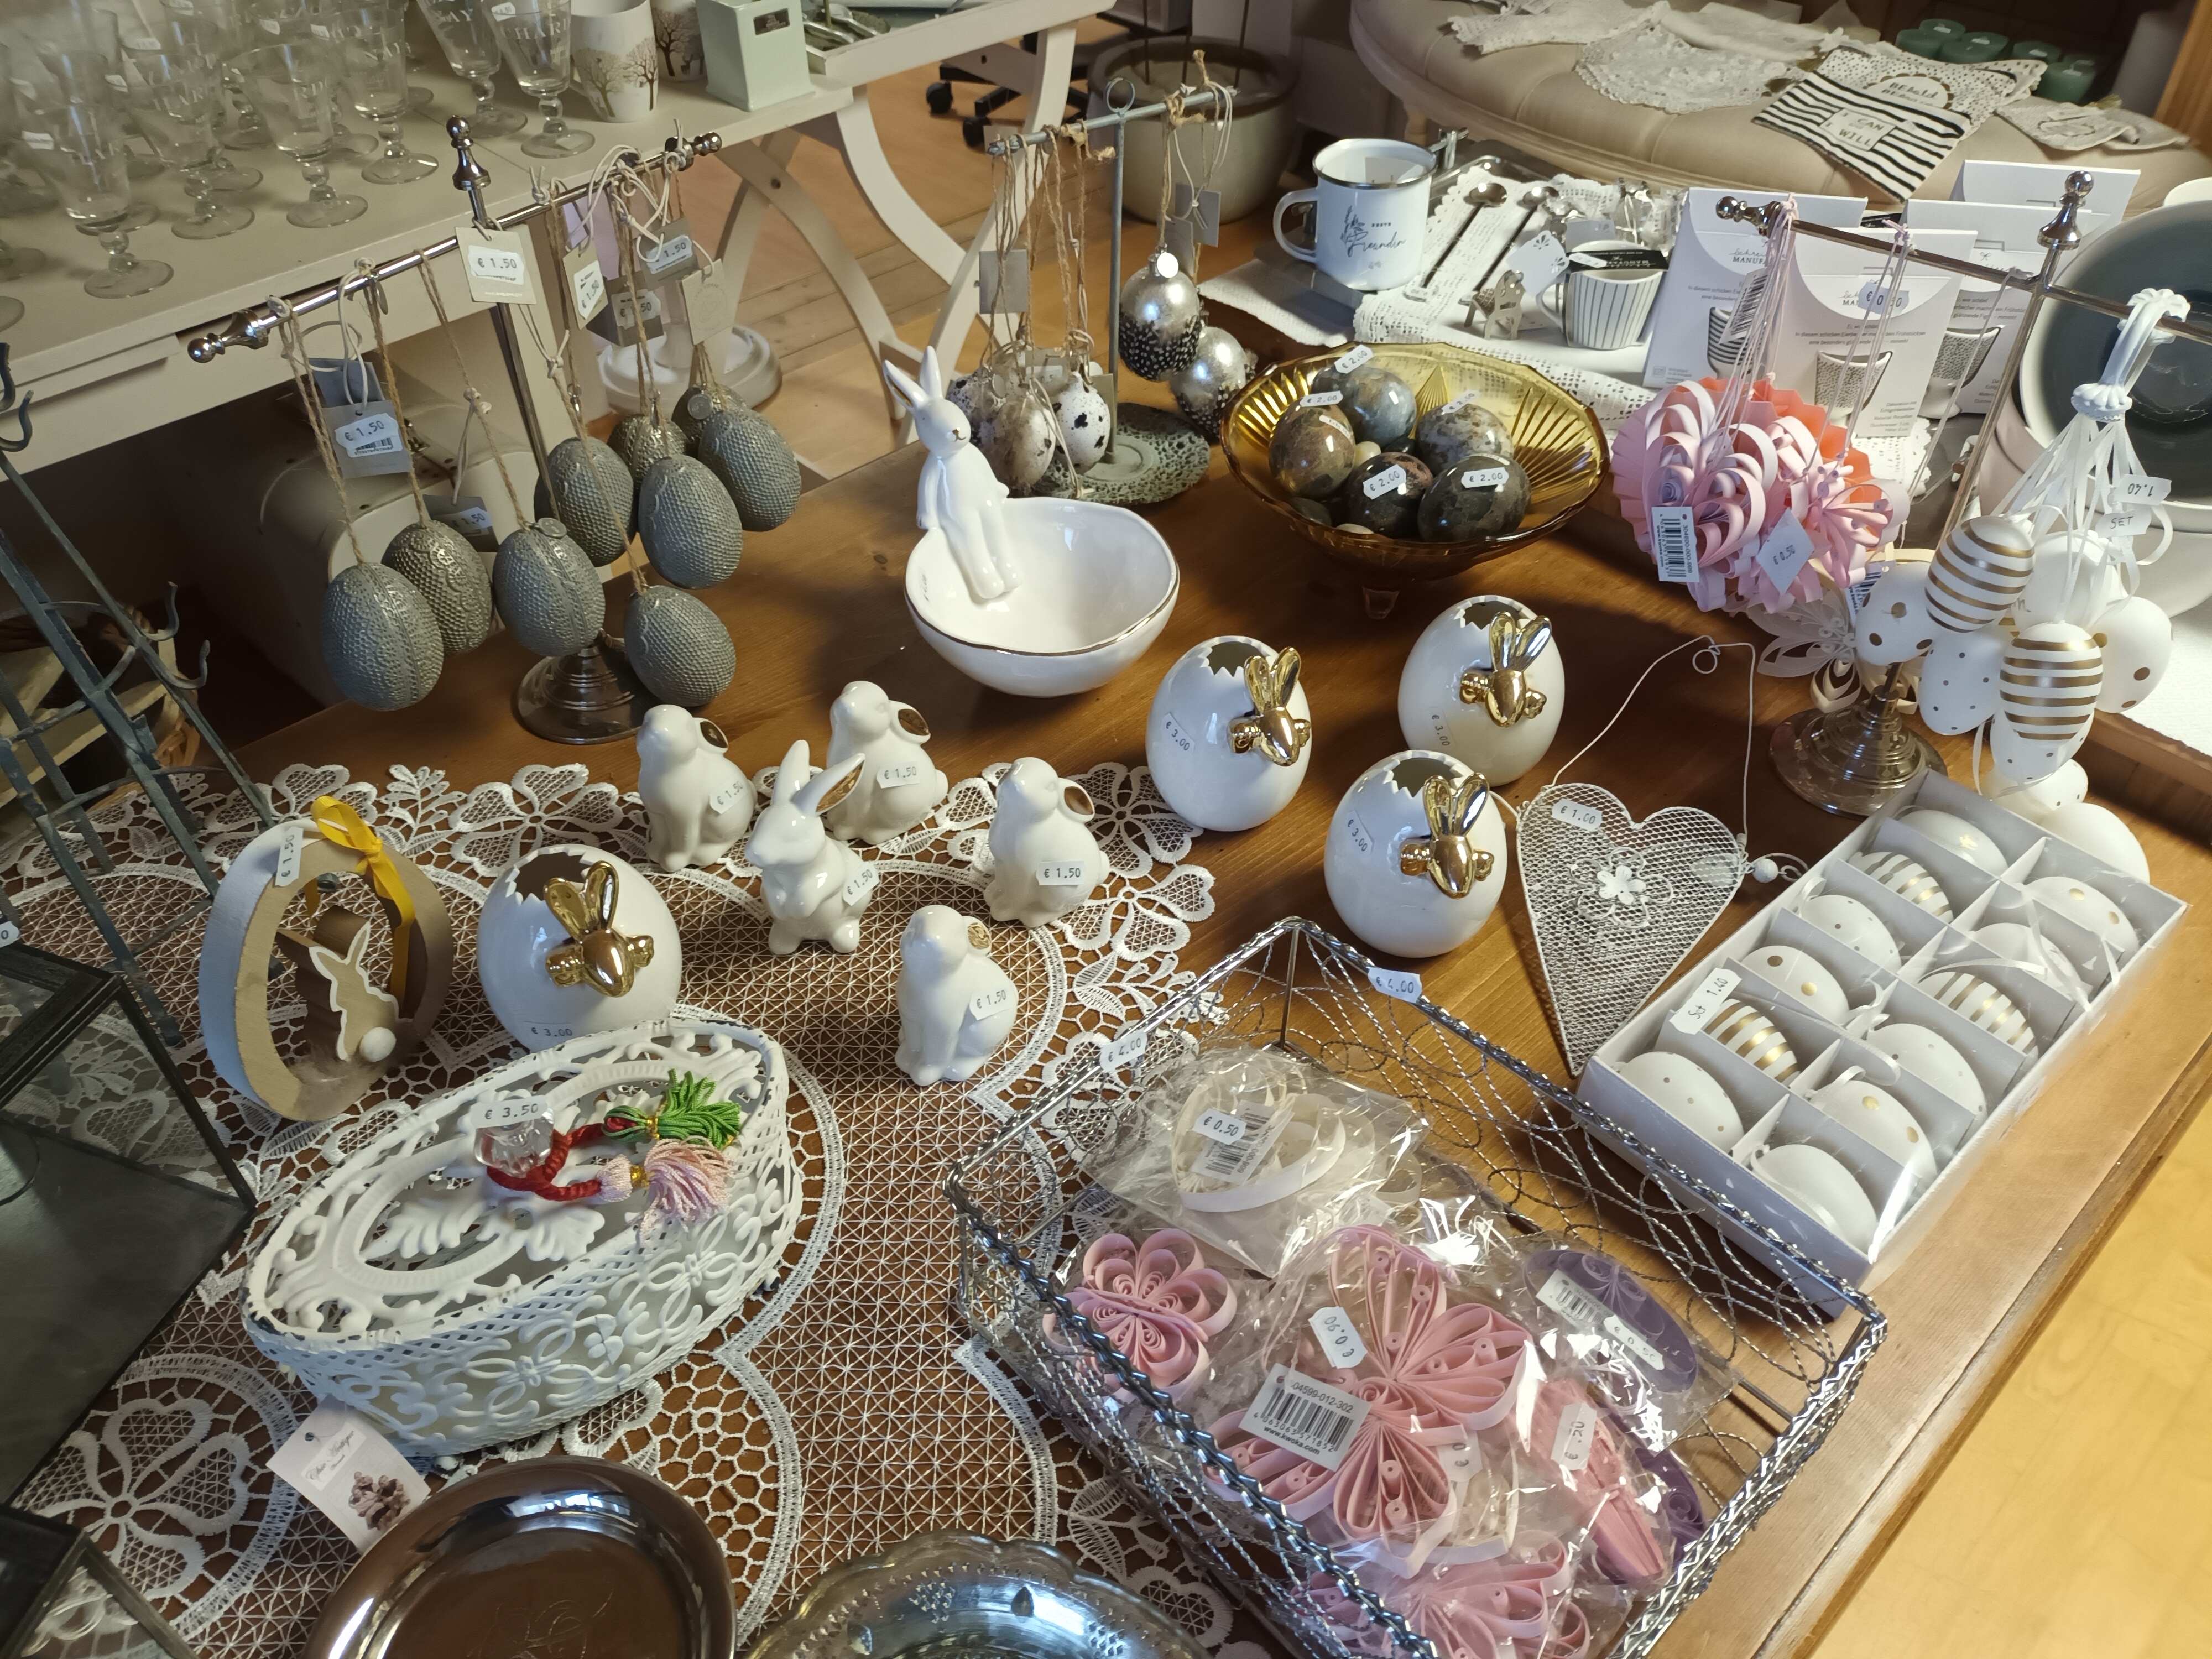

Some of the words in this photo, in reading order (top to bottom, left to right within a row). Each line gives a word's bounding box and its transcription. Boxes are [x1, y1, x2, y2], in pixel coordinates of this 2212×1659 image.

[477, 258, 485, 268] €
[490, 258, 517, 269] 1.50
[1866, 291, 1872, 301] €
[1350, 349, 1368, 364] 2.00
[1316, 395, 1338, 403] 2.00
[1456, 393, 1475, 405] 2.00
[345, 431, 354, 441] €
[356, 420, 385, 437] 1.50
[1370, 483, 1376, 492] €
[1379, 470, 1400, 487] 2.00
[1480, 472, 1504, 482] 2.00
[2127, 483, 2153, 497] 1.40
[2110, 516, 2135, 529] SET
[1171, 729, 1190, 750] 3.00
[1434, 725, 1451, 747] 3.00
[884, 770, 890, 779] €
[895, 766, 917, 778] 1.50
[717, 796, 723, 805] €
[724, 780, 744, 799] 1.50
[1561, 806, 1568, 814] €
[1572, 809, 1596, 824] 1.00
[283, 834, 295, 864] 1.50
[1352, 828, 1368, 852] 3.00
[847, 885, 853, 895] €
[854, 869, 873, 889] 1.50
[1044, 868, 1050, 878] €
[1056, 868, 1081, 878] 1.50
[1376, 976, 1382, 987] €
[1387, 978, 1414, 993] 4.00
[976, 998, 982, 1009] €
[986, 989, 1006, 1005] 1.50
[1688, 1005, 1706, 1019] Set
[1706, 978, 1728, 995] 1.40
[544, 1029, 573, 1037] 3.00
[1108, 1051, 1113, 1062] €
[1119, 1037, 1141, 1056] 4.00
[485, 1109, 493, 1120] €
[502, 1103, 539, 1118] 3.50
[1203, 1116, 1212, 1126] €
[1213, 1120, 1239, 1136] 0.50
[1324, 1316, 1348, 1345] 0.90
[1342, 1348, 1354, 1357] €
[1627, 1337, 1656, 1362] 0.50
[1290, 1382, 1354, 1413] 04599-012-302
[1264, 1426, 1321, 1455] www.kwoka.com
